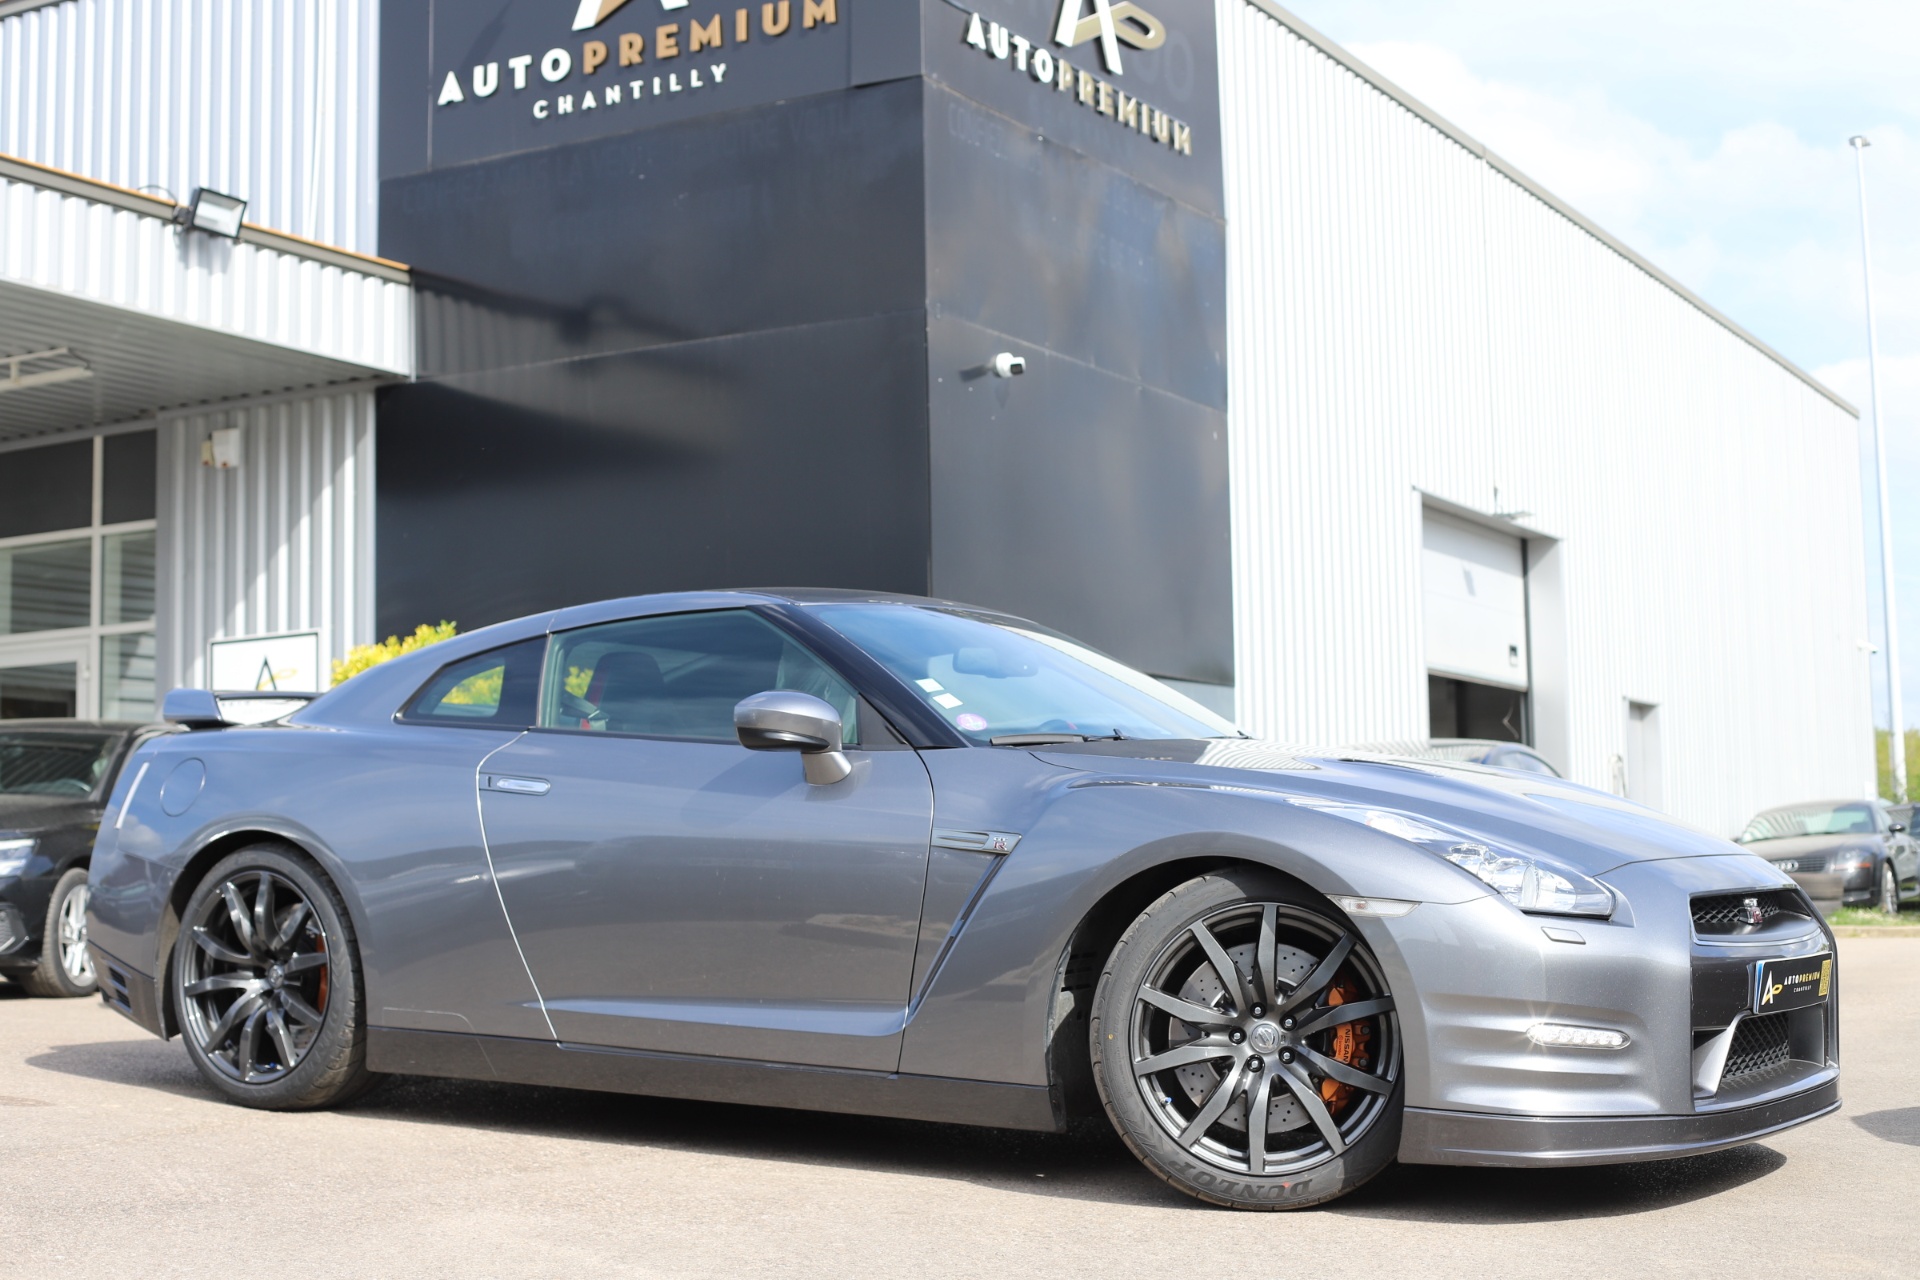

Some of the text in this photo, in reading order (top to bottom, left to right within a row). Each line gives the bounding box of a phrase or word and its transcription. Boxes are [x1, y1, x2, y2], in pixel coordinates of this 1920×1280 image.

[533, 63, 727, 119] CHANTILLY
[967, 12, 1192, 156] AUTOPREMIUM
[1343, 1028, 1351, 1062] NISSAN
[1168, 1160, 1312, 1200] DUNLOP
